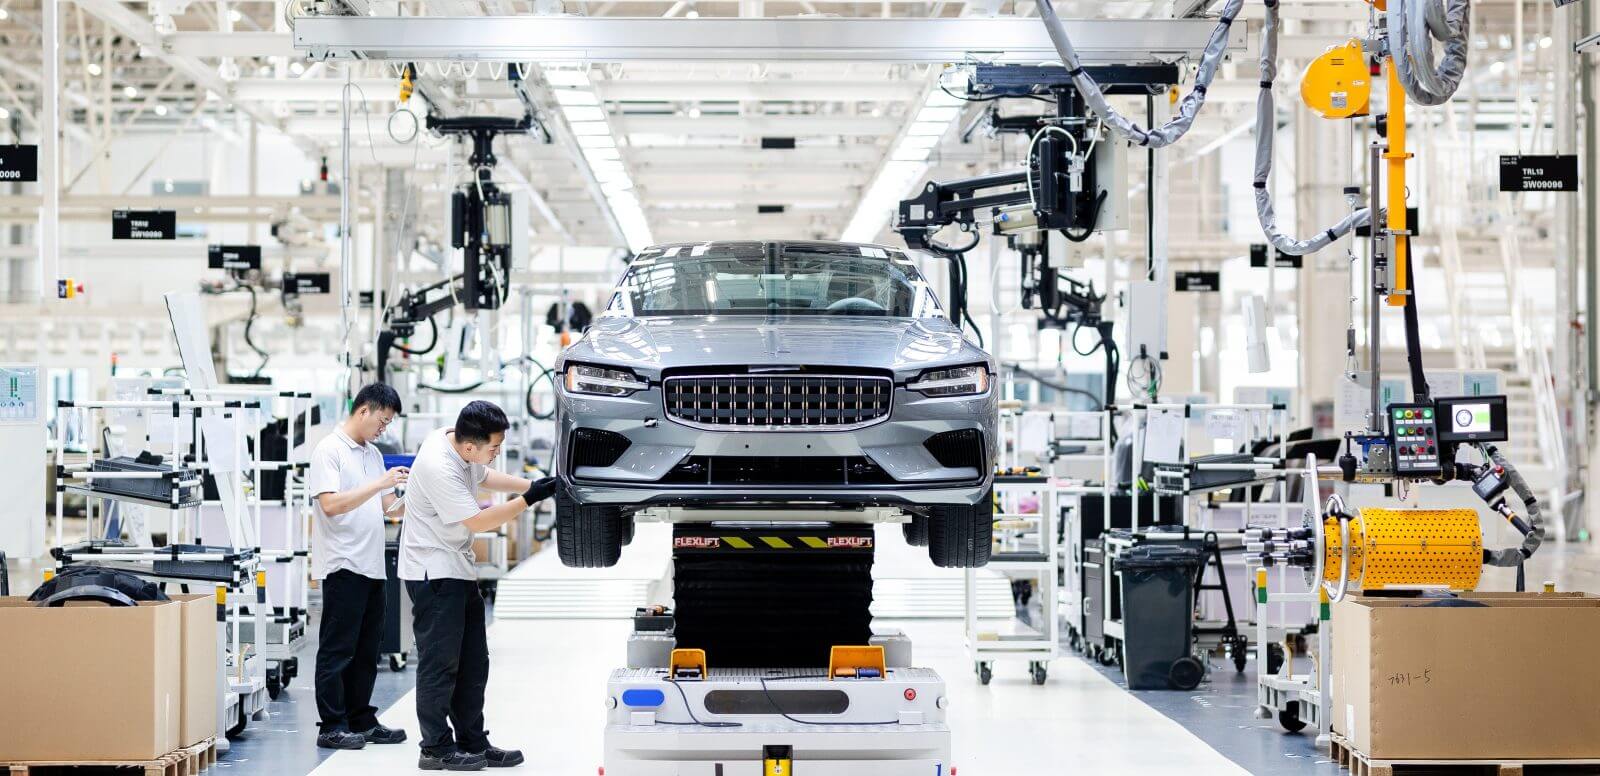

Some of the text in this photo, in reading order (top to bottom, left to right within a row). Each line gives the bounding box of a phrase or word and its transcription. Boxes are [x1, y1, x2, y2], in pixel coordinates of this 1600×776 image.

[1522, 168, 1544, 176] TRL13
[674, 537, 720, 547] FLEXLIFT
[827, 537, 872, 547] FLEXLIFT
